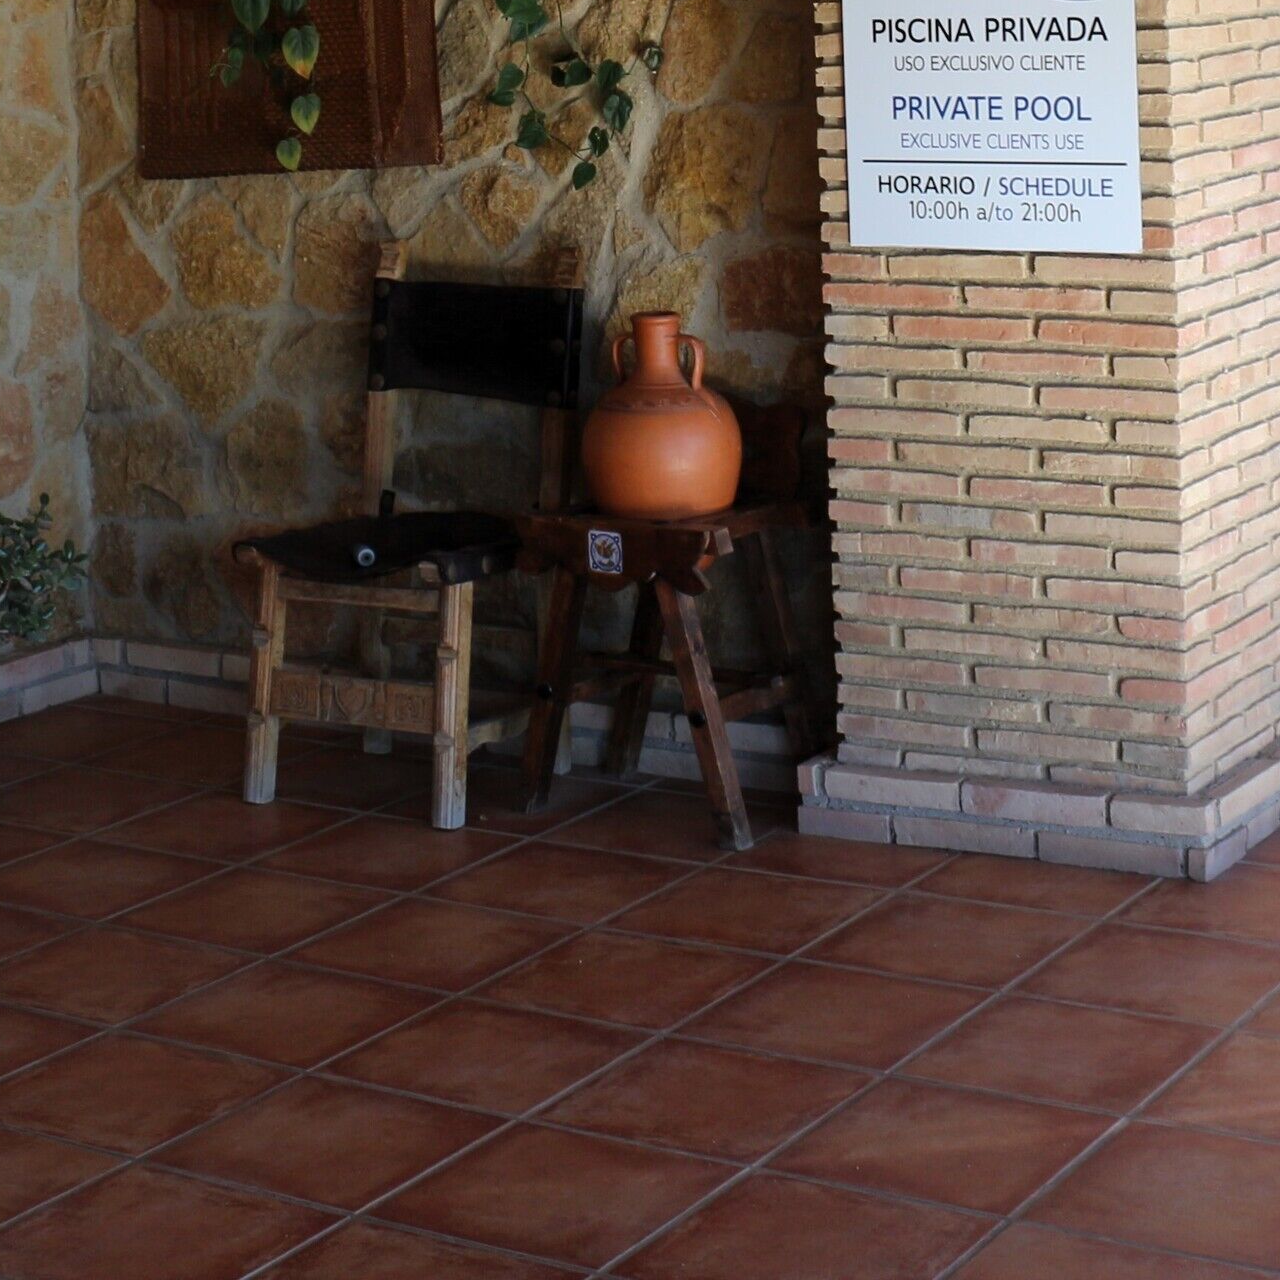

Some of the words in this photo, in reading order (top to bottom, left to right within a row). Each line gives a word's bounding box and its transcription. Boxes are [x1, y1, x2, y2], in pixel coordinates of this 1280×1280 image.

[871, 18, 975, 43] PISCINA
[985, 16, 1109, 42] PRIVADA
[894, 55, 926, 71] USO
[930, 55, 1015, 71] EXCLUSIVO
[1019, 55, 1087, 71] CLIENTE
[892, 96, 1004, 121] PRIVATE
[1014, 96, 1093, 121] POOL
[900, 132, 982, 149] EXCLUSIVE
[986, 133, 1050, 150] CLIENTS
[1055, 134, 1085, 150] USE
[878, 175, 976, 195] HORARIO
[983, 176, 992, 197] /
[999, 177, 1115, 197] SCHEDULE
[909, 200, 970, 220] 10:00h
[976, 202, 1014, 222] a/to
[1021, 202, 1082, 223] 21:00h
